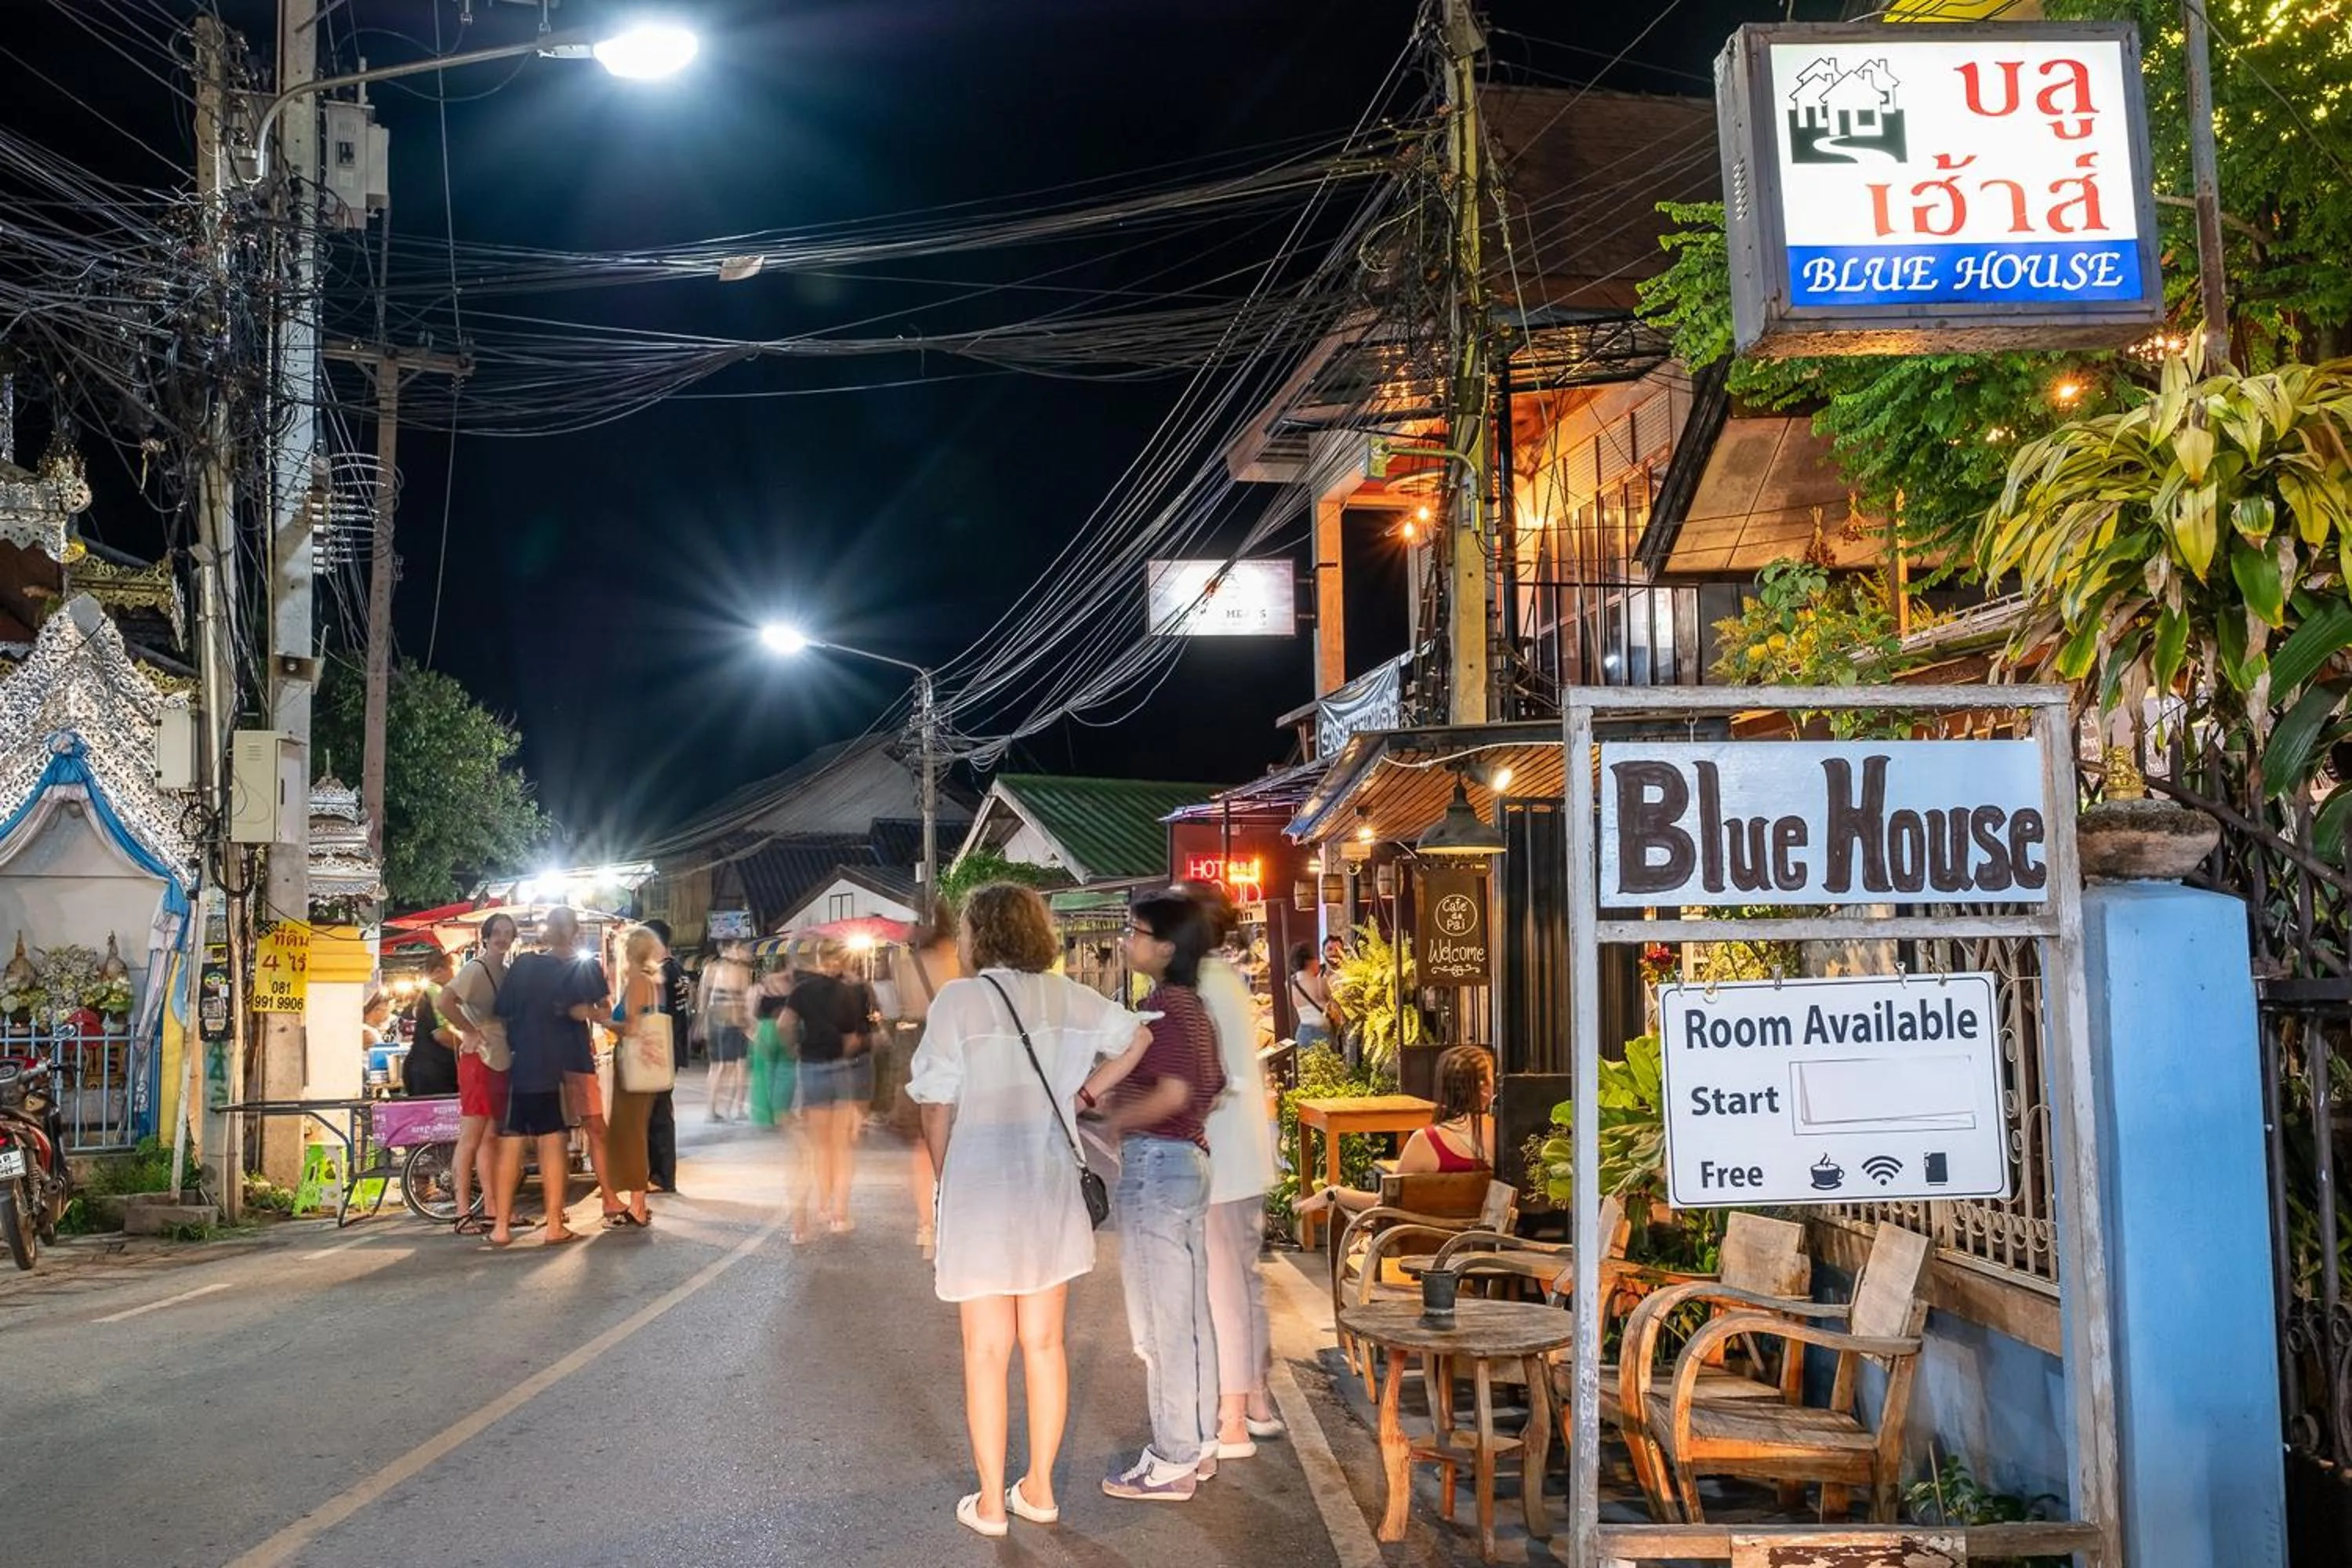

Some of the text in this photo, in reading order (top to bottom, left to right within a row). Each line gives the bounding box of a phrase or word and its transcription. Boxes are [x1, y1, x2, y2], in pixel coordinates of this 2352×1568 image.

[1953, 57, 2101, 140] บลู
[1803, 249, 2125, 293] BLUE HOUSE
[1610, 754, 2047, 895] Blue House
[1190, 859, 1226, 880] HOT
[262, 955, 281, 971] 4
[1428, 938, 1486, 964] Welcome
[255, 995, 304, 1011] 991 9906
[1685, 996, 1979, 1050] Room Available
[1690, 1085, 1780, 1116] Start
[1700, 1160, 1764, 1189] Free
